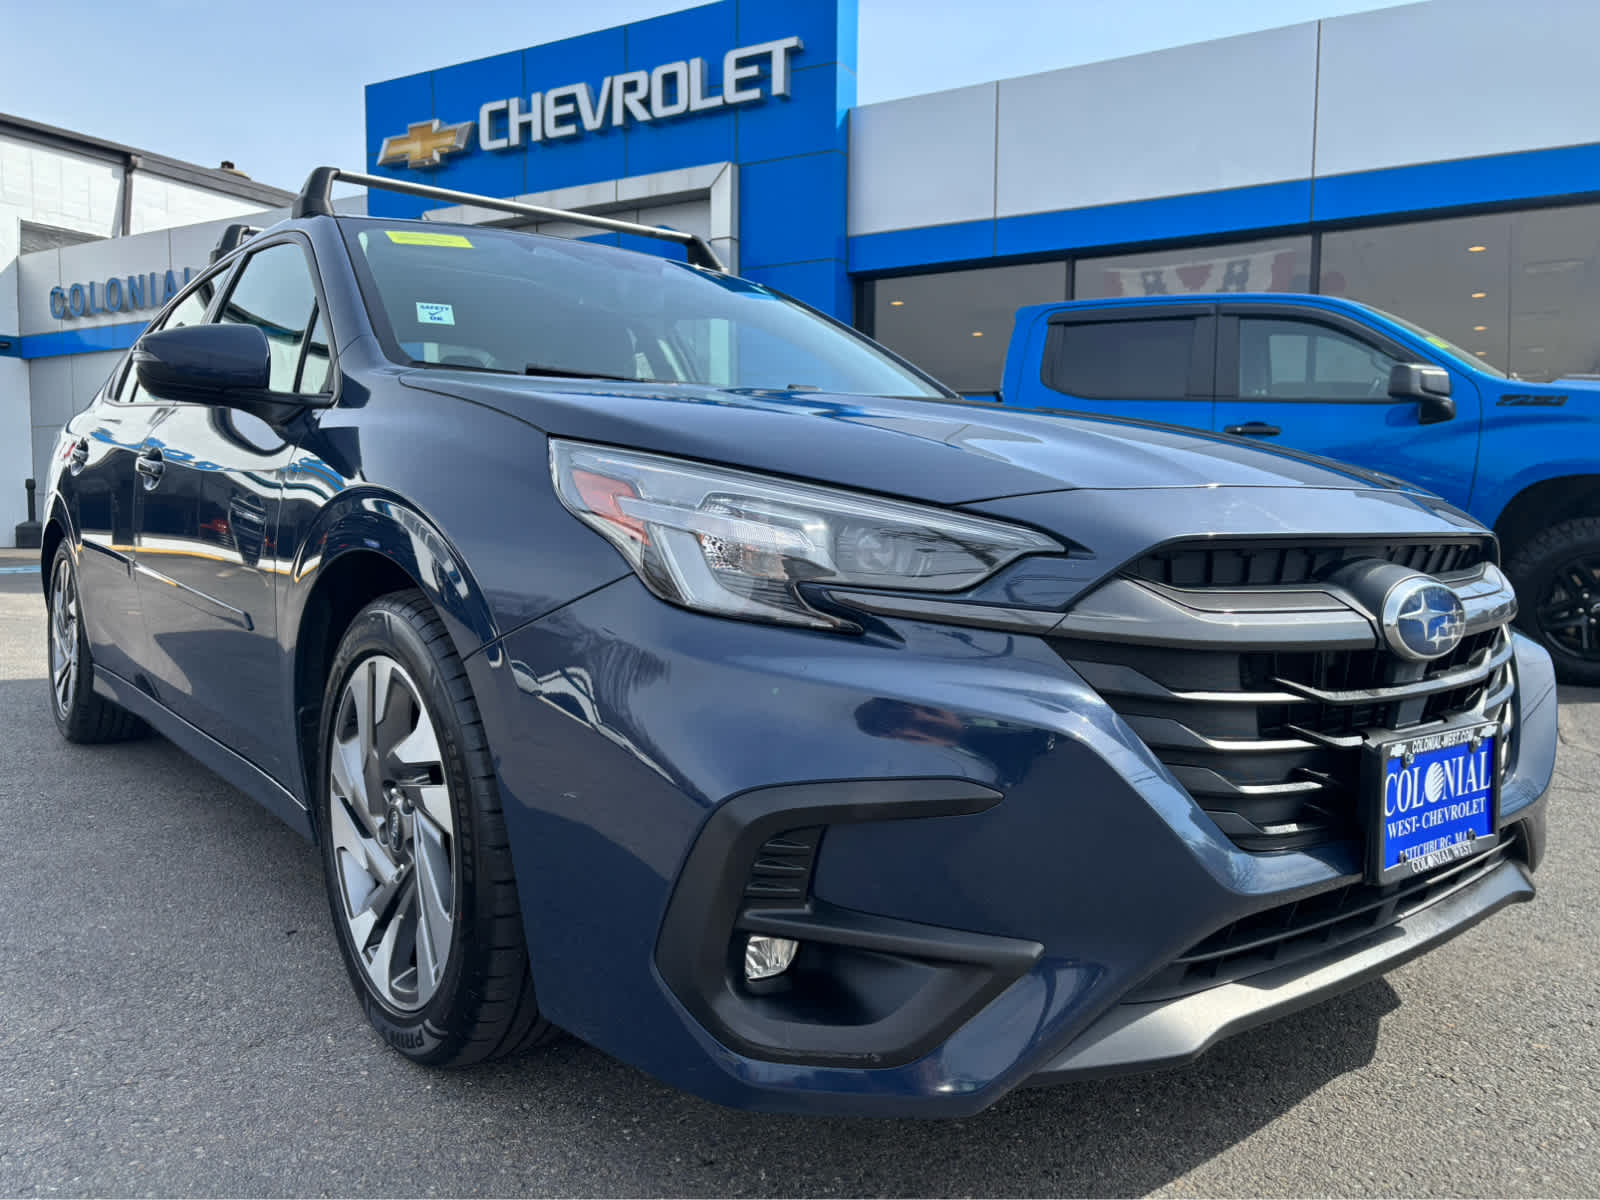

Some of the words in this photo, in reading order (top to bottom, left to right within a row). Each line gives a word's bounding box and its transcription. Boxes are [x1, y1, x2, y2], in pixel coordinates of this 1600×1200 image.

[479, 36, 804, 151] CHEVROLET
[1384, 751, 1492, 817] COLONIAL
[1411, 847, 1453, 873] COLONIAL
[1452, 842, 1473, 858] WEST
